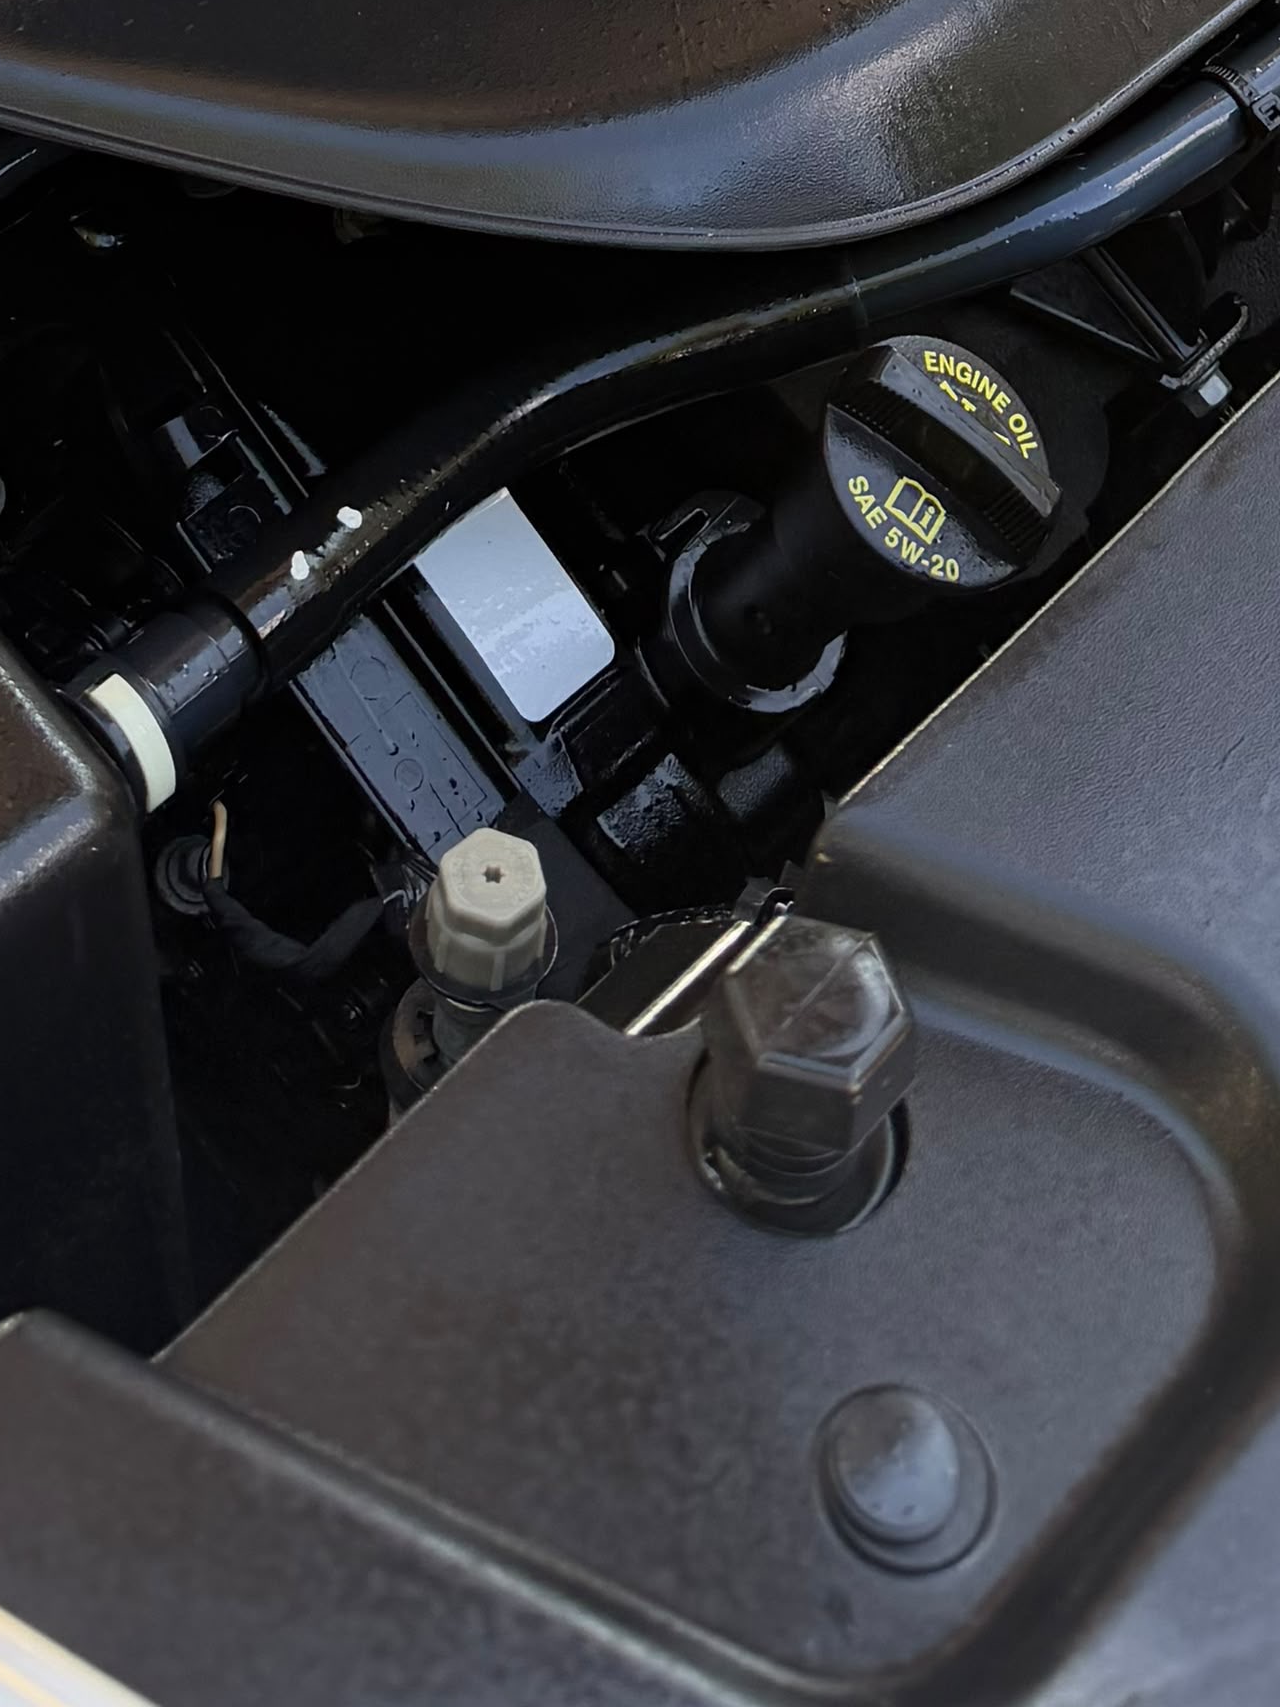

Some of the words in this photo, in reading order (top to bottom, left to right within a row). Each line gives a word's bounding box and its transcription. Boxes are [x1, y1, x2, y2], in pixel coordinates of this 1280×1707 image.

[923, 350, 1012, 415] ENGINE
[1007, 412, 1041, 459] OIL
[848, 474, 888, 530] SAE
[884, 526, 960, 582] 5W-20
